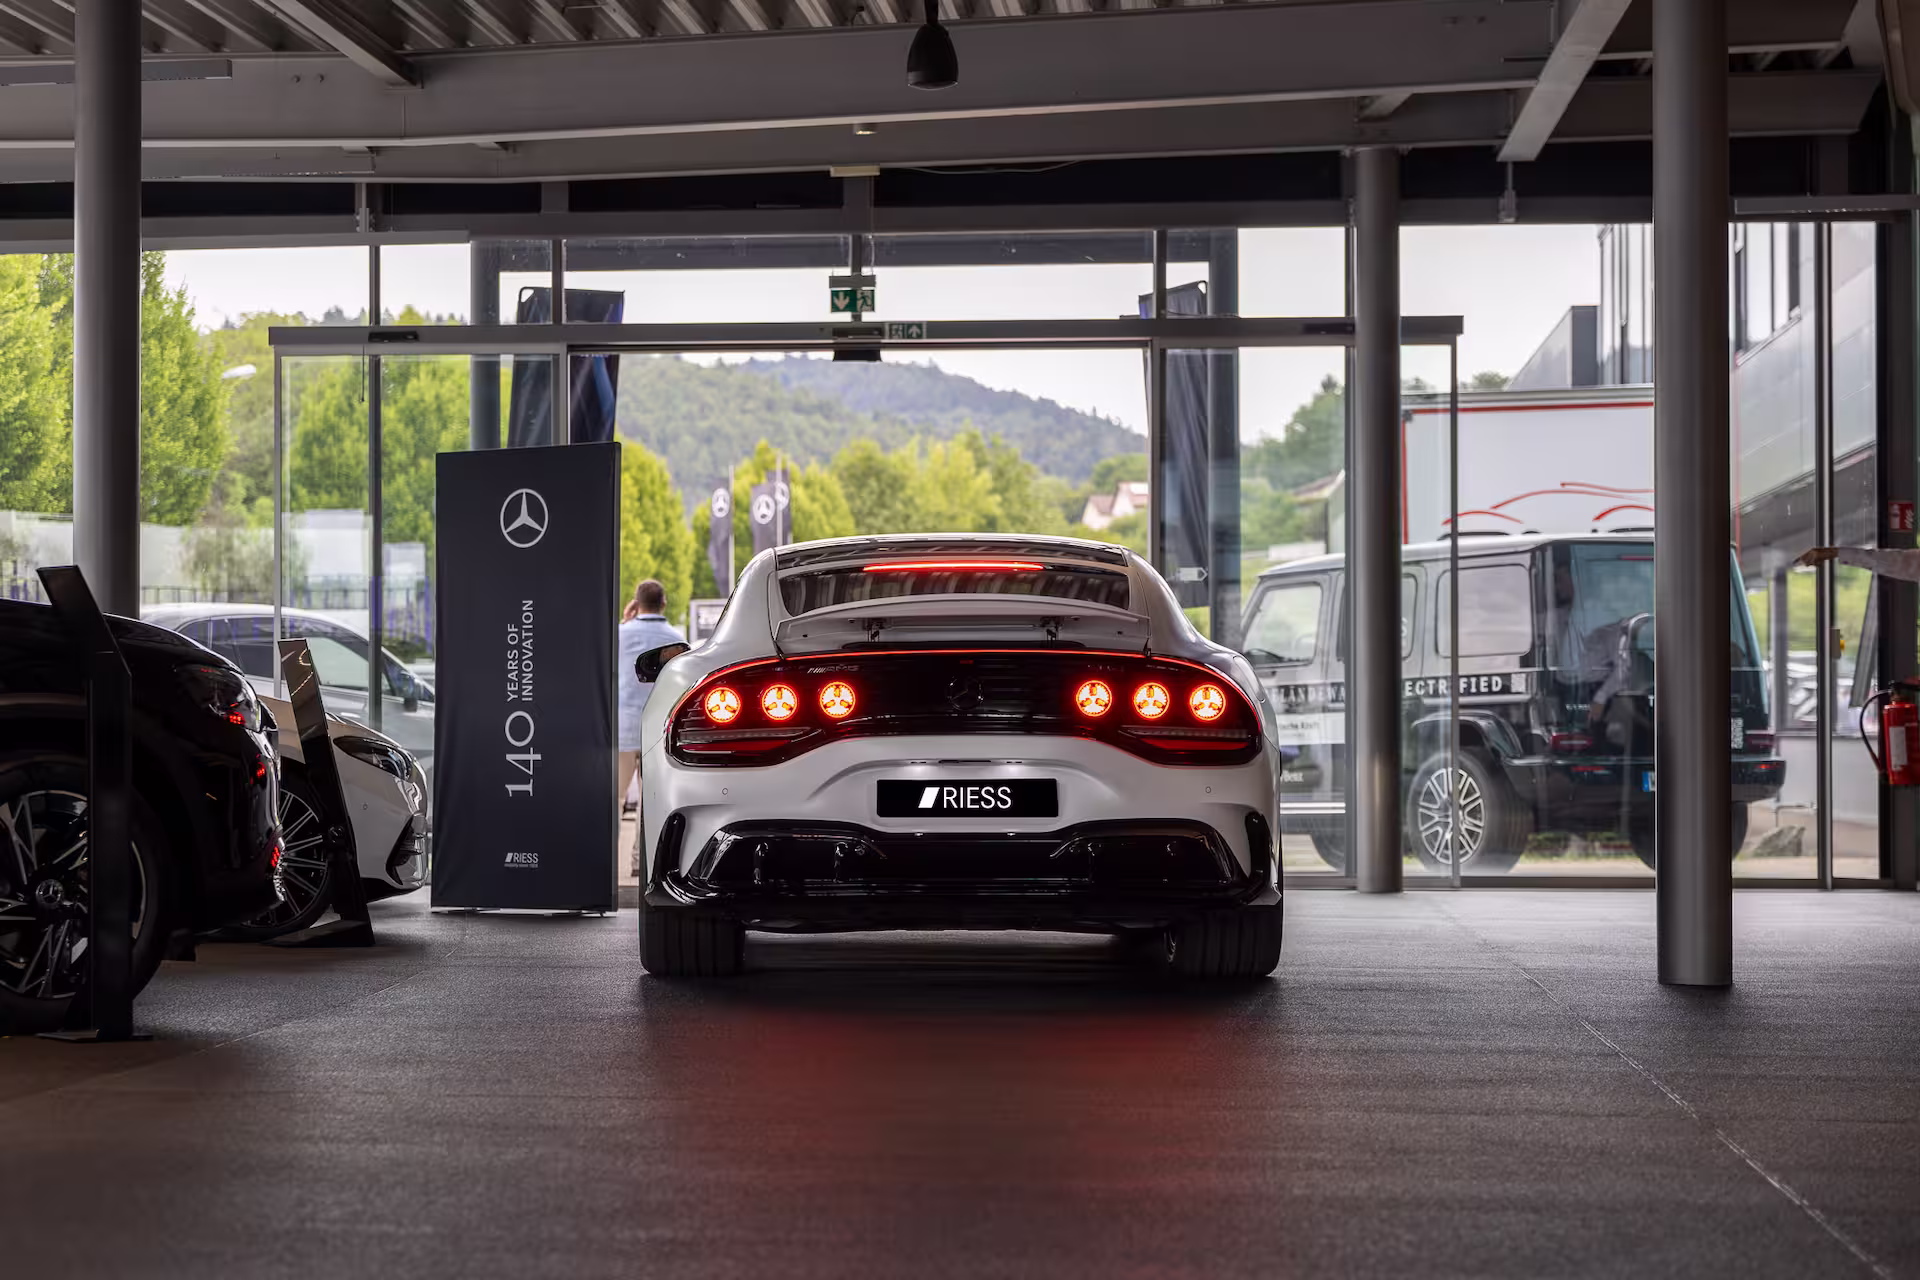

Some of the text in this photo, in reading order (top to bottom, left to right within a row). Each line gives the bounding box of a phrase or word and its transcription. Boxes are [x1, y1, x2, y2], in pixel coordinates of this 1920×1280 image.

[506, 623, 519, 702] YEARS OF
[521, 599, 534, 701] INNOVATION
[1404, 676, 1503, 697] ECTRFIED
[505, 710, 542, 797] 140
[943, 787, 1012, 809] RIESS
[513, 852, 539, 864] RIESS
